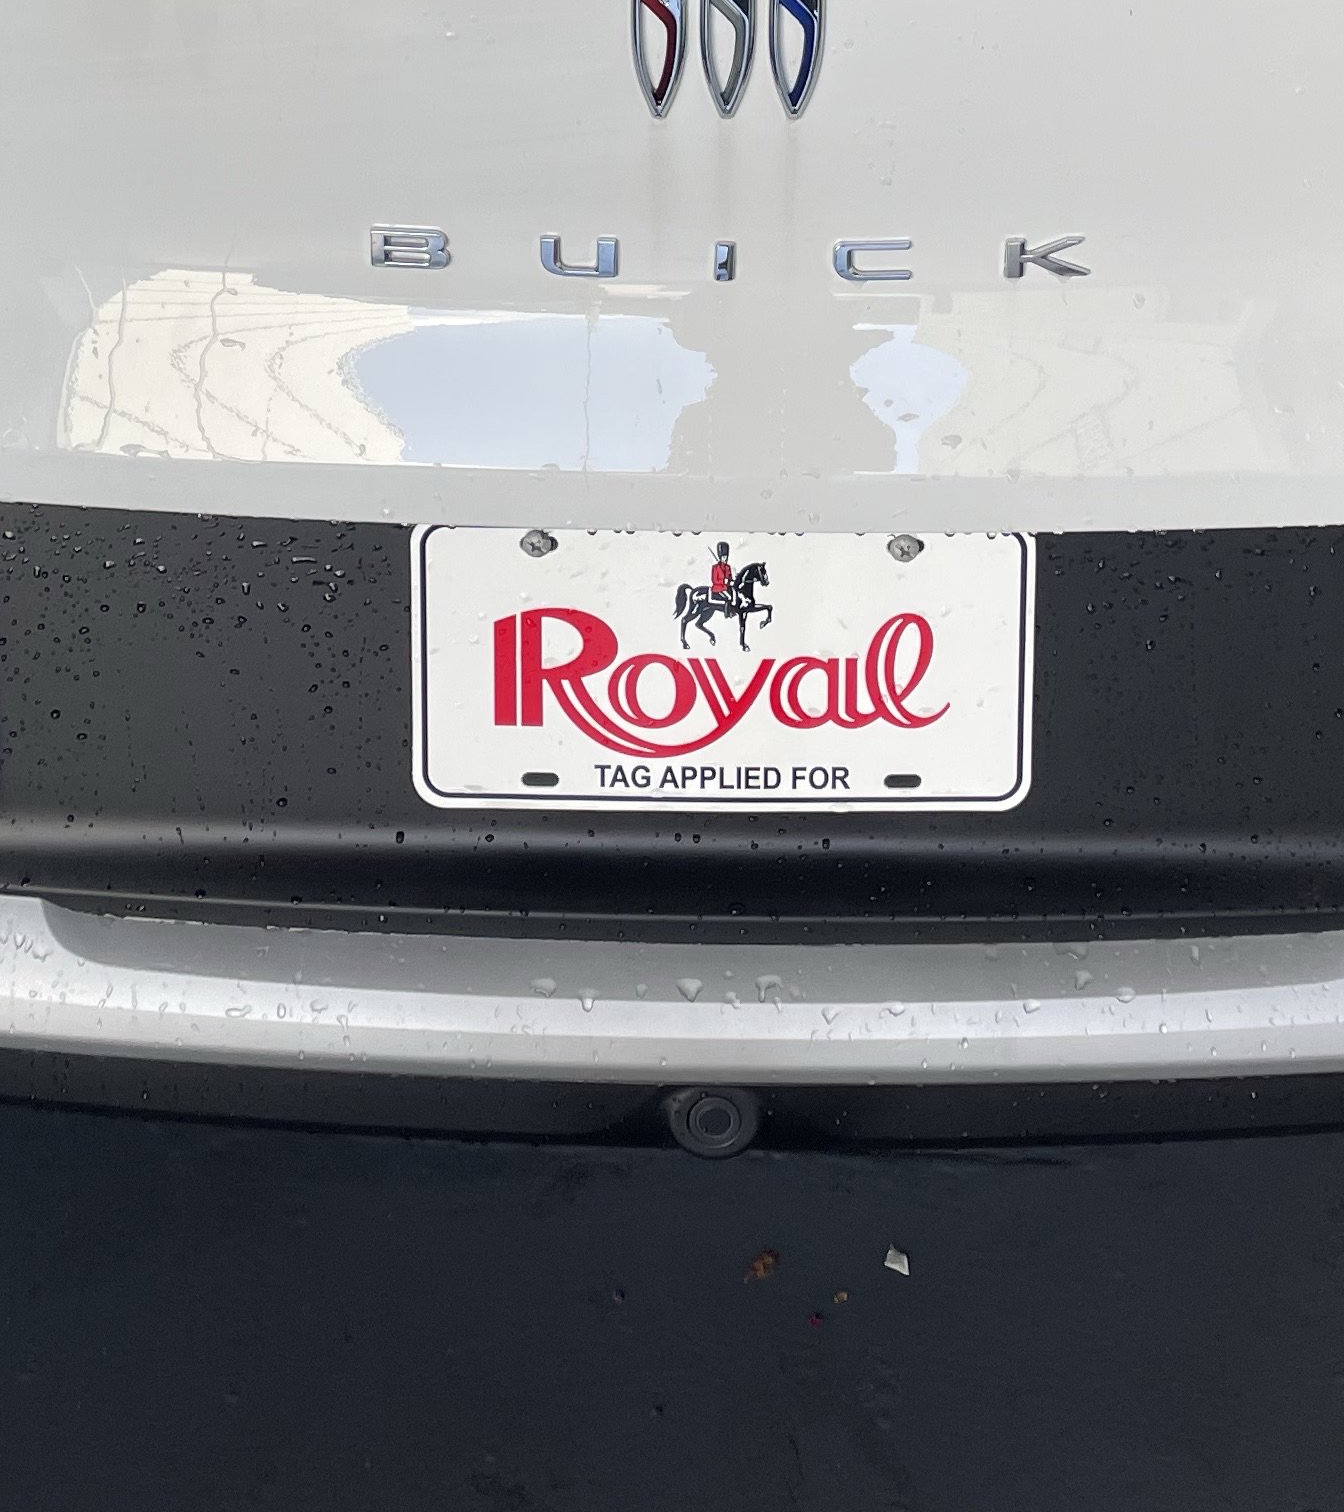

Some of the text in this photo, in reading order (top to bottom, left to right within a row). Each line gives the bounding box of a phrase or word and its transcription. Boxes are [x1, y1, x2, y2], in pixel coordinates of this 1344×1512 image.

[369, 225, 1091, 283] BUICK
[493, 607, 951, 758] Royal
[594, 763, 851, 791] TAG APPLIED FOR
